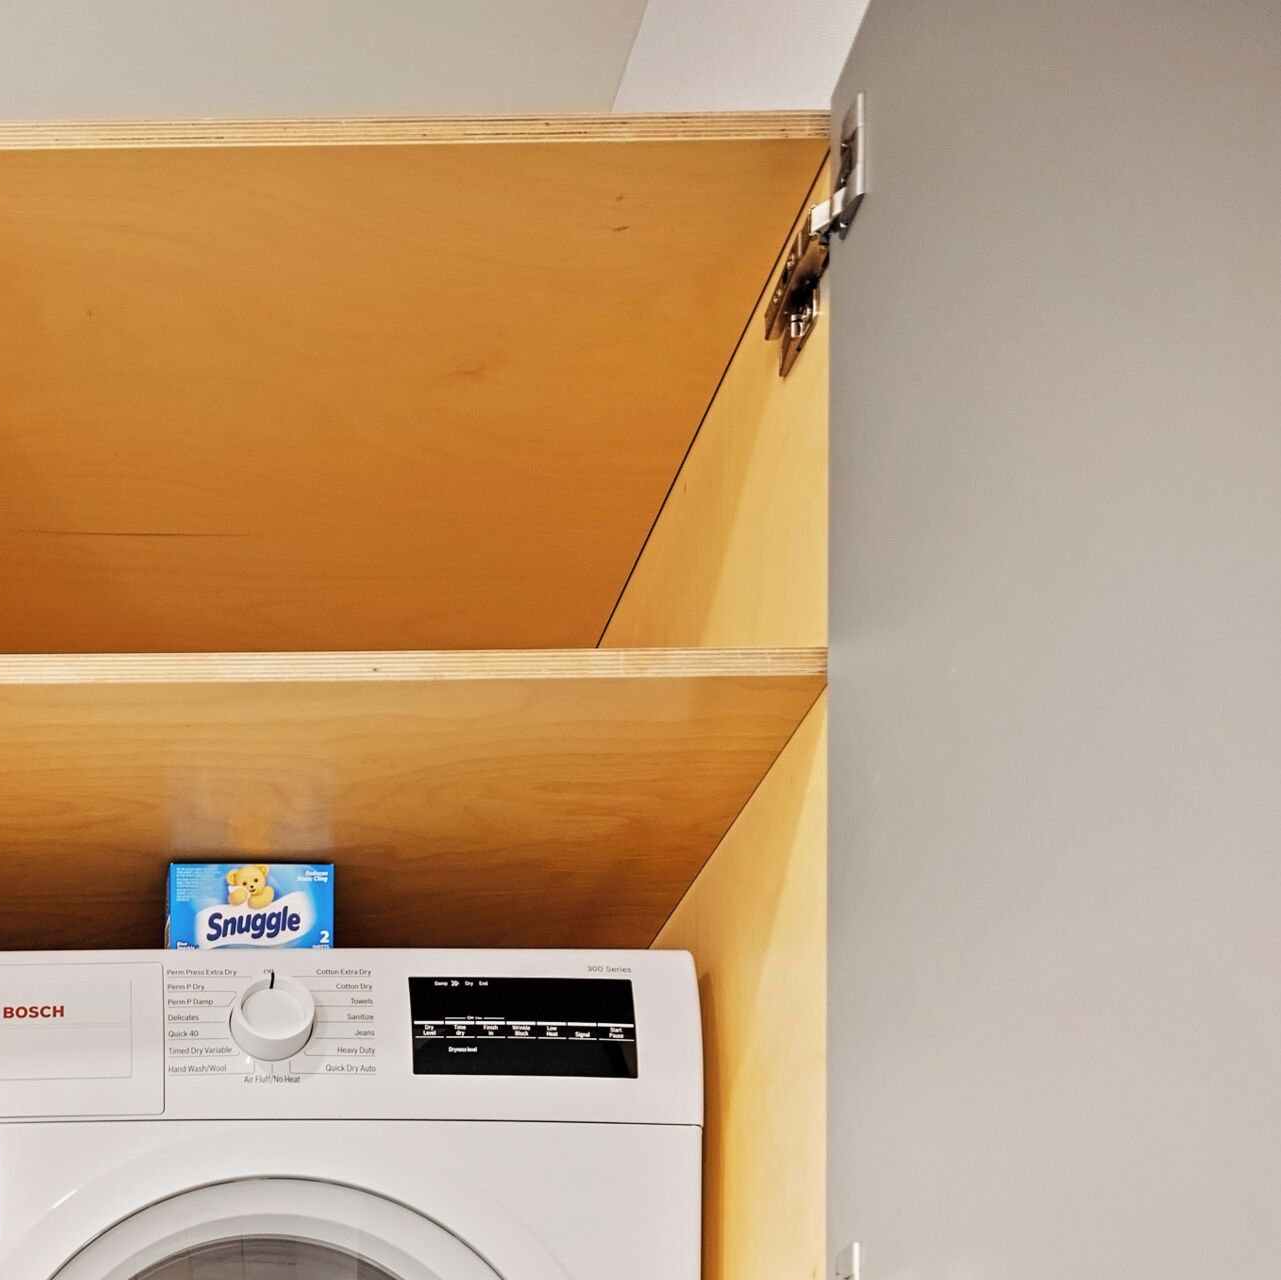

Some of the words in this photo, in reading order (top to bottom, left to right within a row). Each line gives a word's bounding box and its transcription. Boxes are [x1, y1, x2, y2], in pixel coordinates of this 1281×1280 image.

[314, 875, 328, 883] Cling
[206, 906, 301, 941] Snuggle
[320, 931, 329, 943] 2
[3, 1006, 64, 1018] BOSCH
[168, 1030, 187, 1038] Quick
[191, 1047, 203, 1055] Dry
[337, 1046, 358, 1054] Heavy
[360, 1046, 375, 1054] Duty
[346, 1065, 359, 1073] Dry
[255, 1075, 283, 1083] Fluff/No
